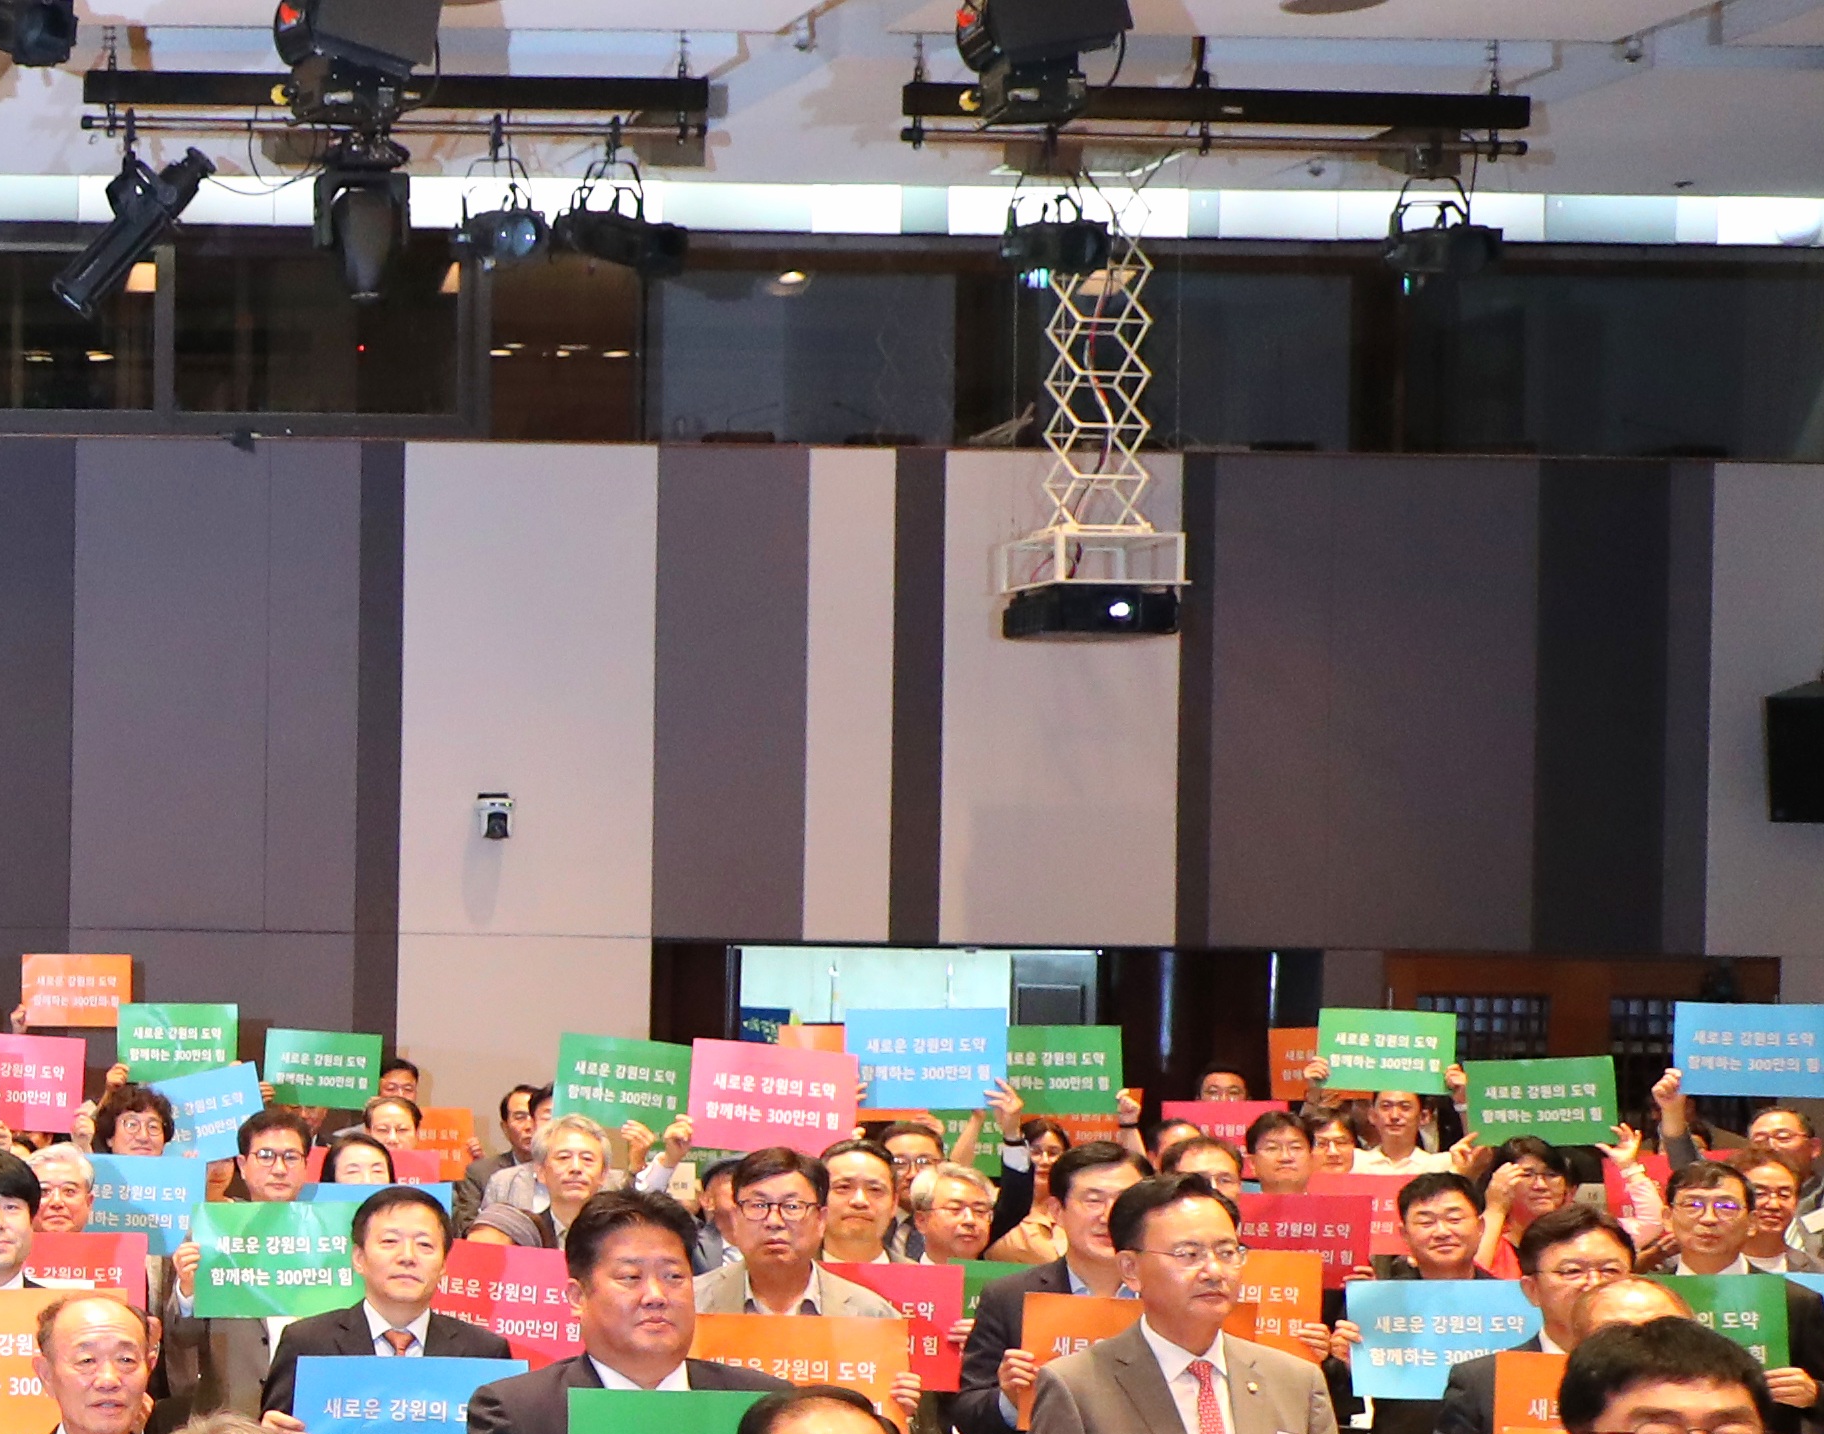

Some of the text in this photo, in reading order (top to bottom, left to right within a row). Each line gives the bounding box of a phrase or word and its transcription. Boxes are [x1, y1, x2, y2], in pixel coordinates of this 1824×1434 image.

[866, 1036, 907, 1055] 새로운
[913, 1038, 953, 1054] 강원의
[1374, 1033, 1410, 1049] 강원의
[863, 1064, 991, 1081] 함께하는 300만의 힘
[1329, 1054, 1376, 1073] 함께하는
[713, 1072, 834, 1100] 새로운 강원의 도약
[706, 1101, 839, 1131] 함께하는 300만의 힘
[219, 1236, 345, 1257] 새로운 강원의 도약
[211, 1265, 352, 1287] 함께하는 300만의 힘
[1374, 1316, 1523, 1334] 새로운 강원의 도약
[1369, 1348, 1438, 1367] 함께하는
[323, 1398, 447, 1427] 새로운 강원의
